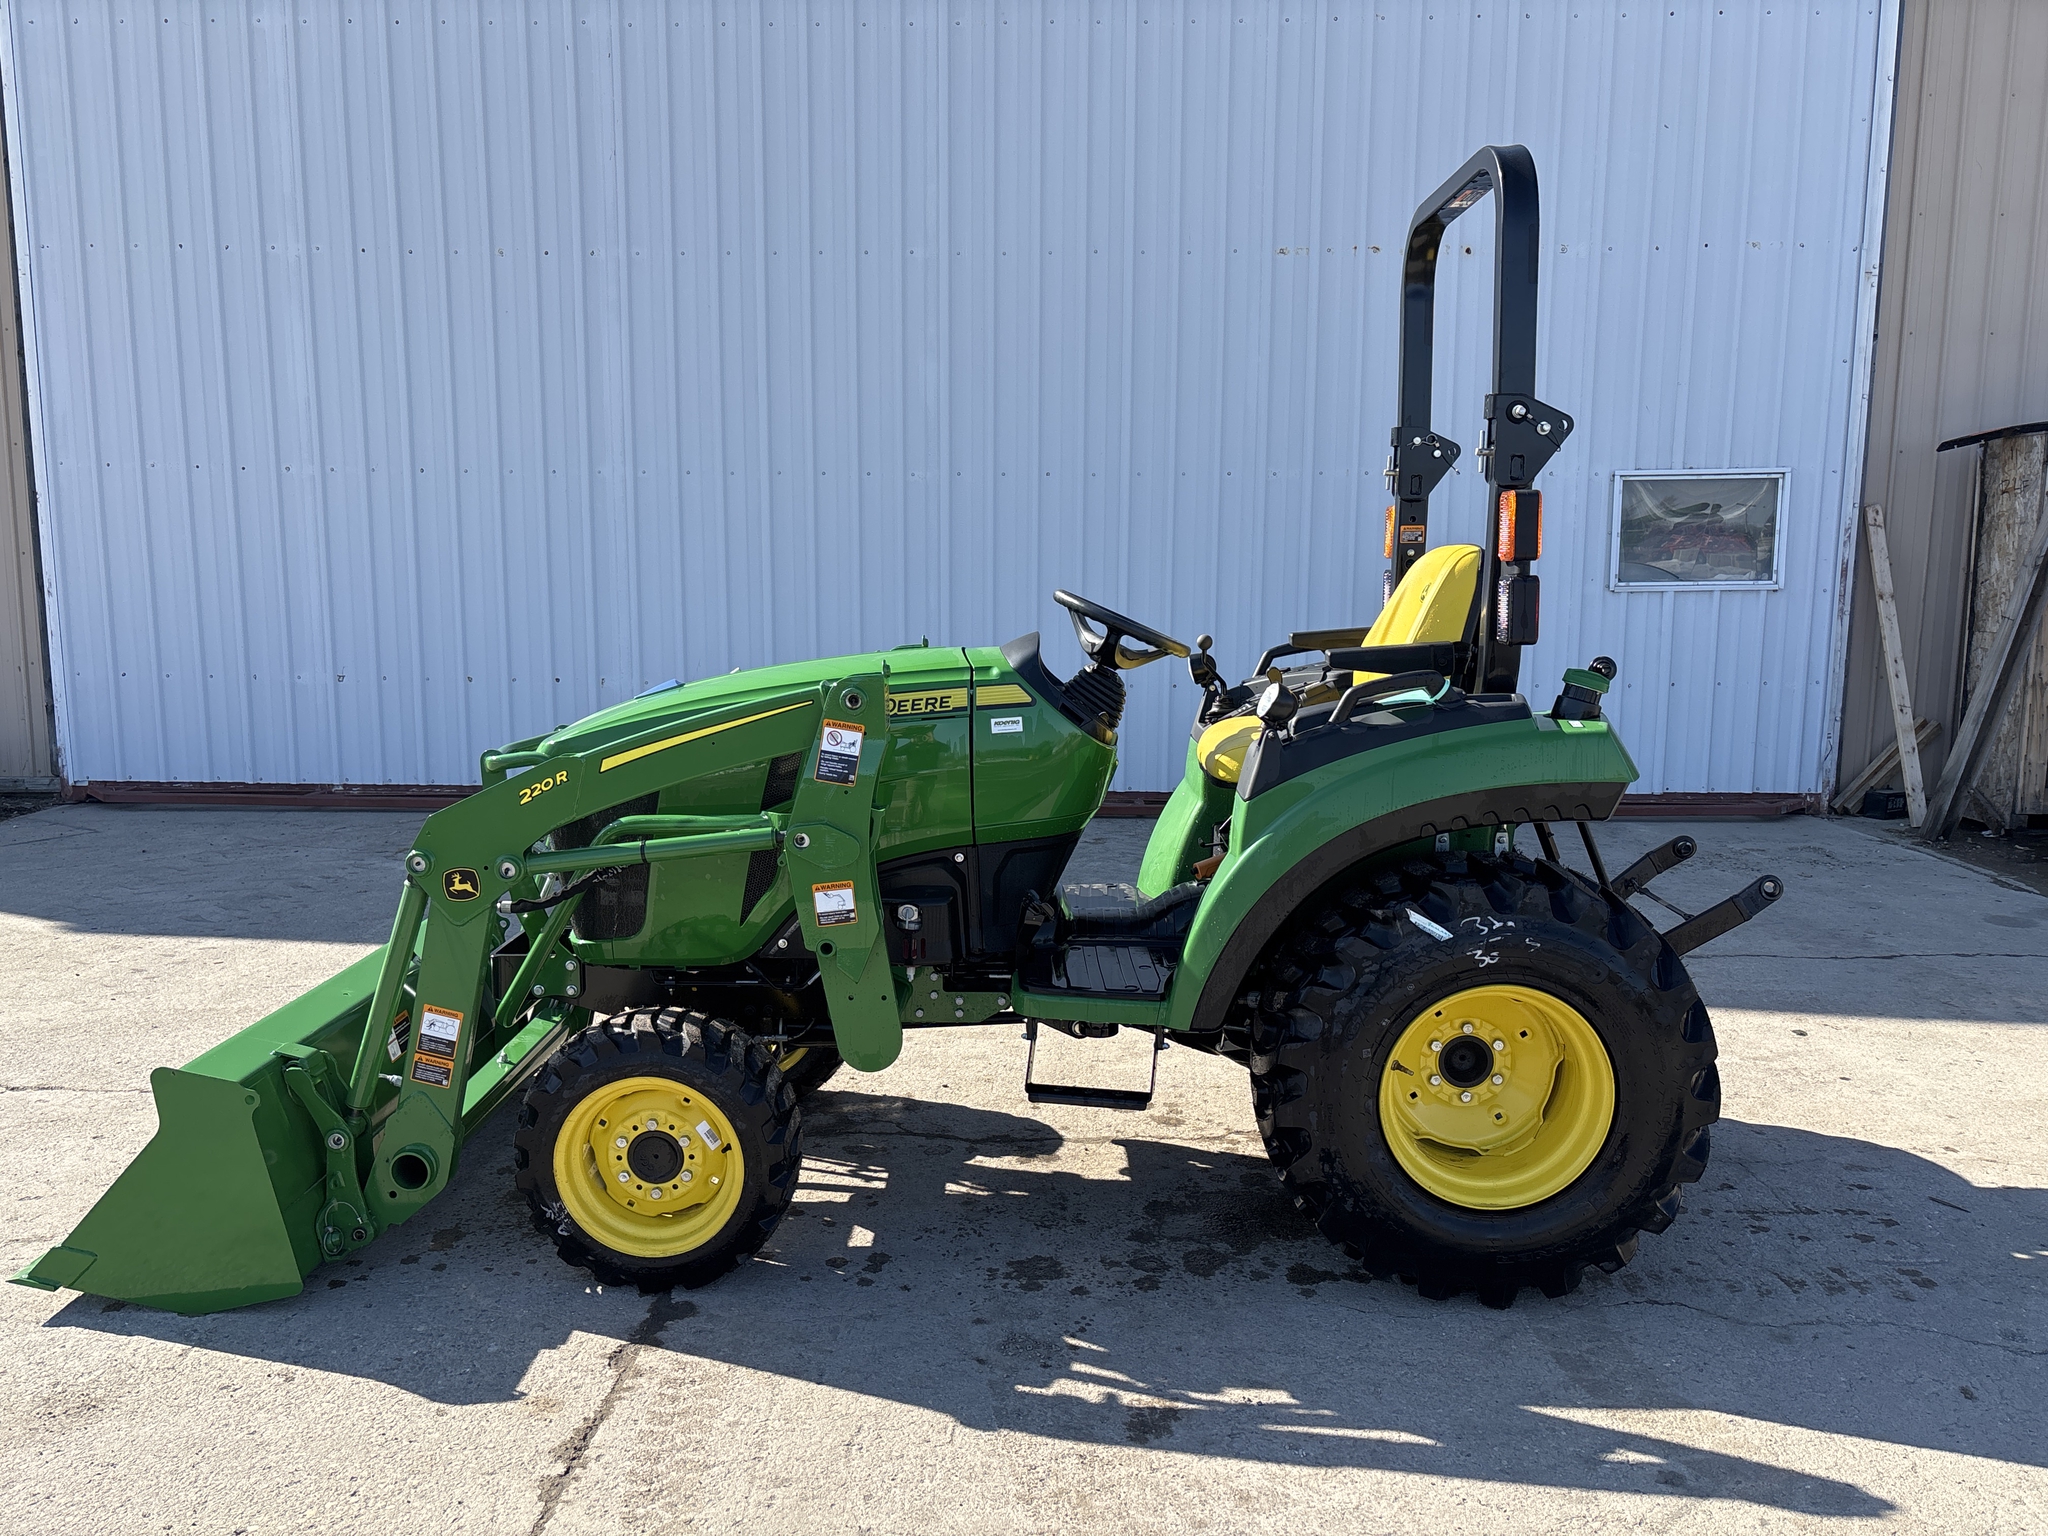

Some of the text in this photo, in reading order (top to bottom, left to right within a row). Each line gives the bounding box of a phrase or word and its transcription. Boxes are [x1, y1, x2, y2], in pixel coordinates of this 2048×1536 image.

[832, 721, 863, 732] WARNING
[519, 770, 568, 805] 220 R
[820, 882, 851, 890] WARNING
[434, 1008, 459, 1018] WARNING
[425, 1057, 450, 1067] WARNING
